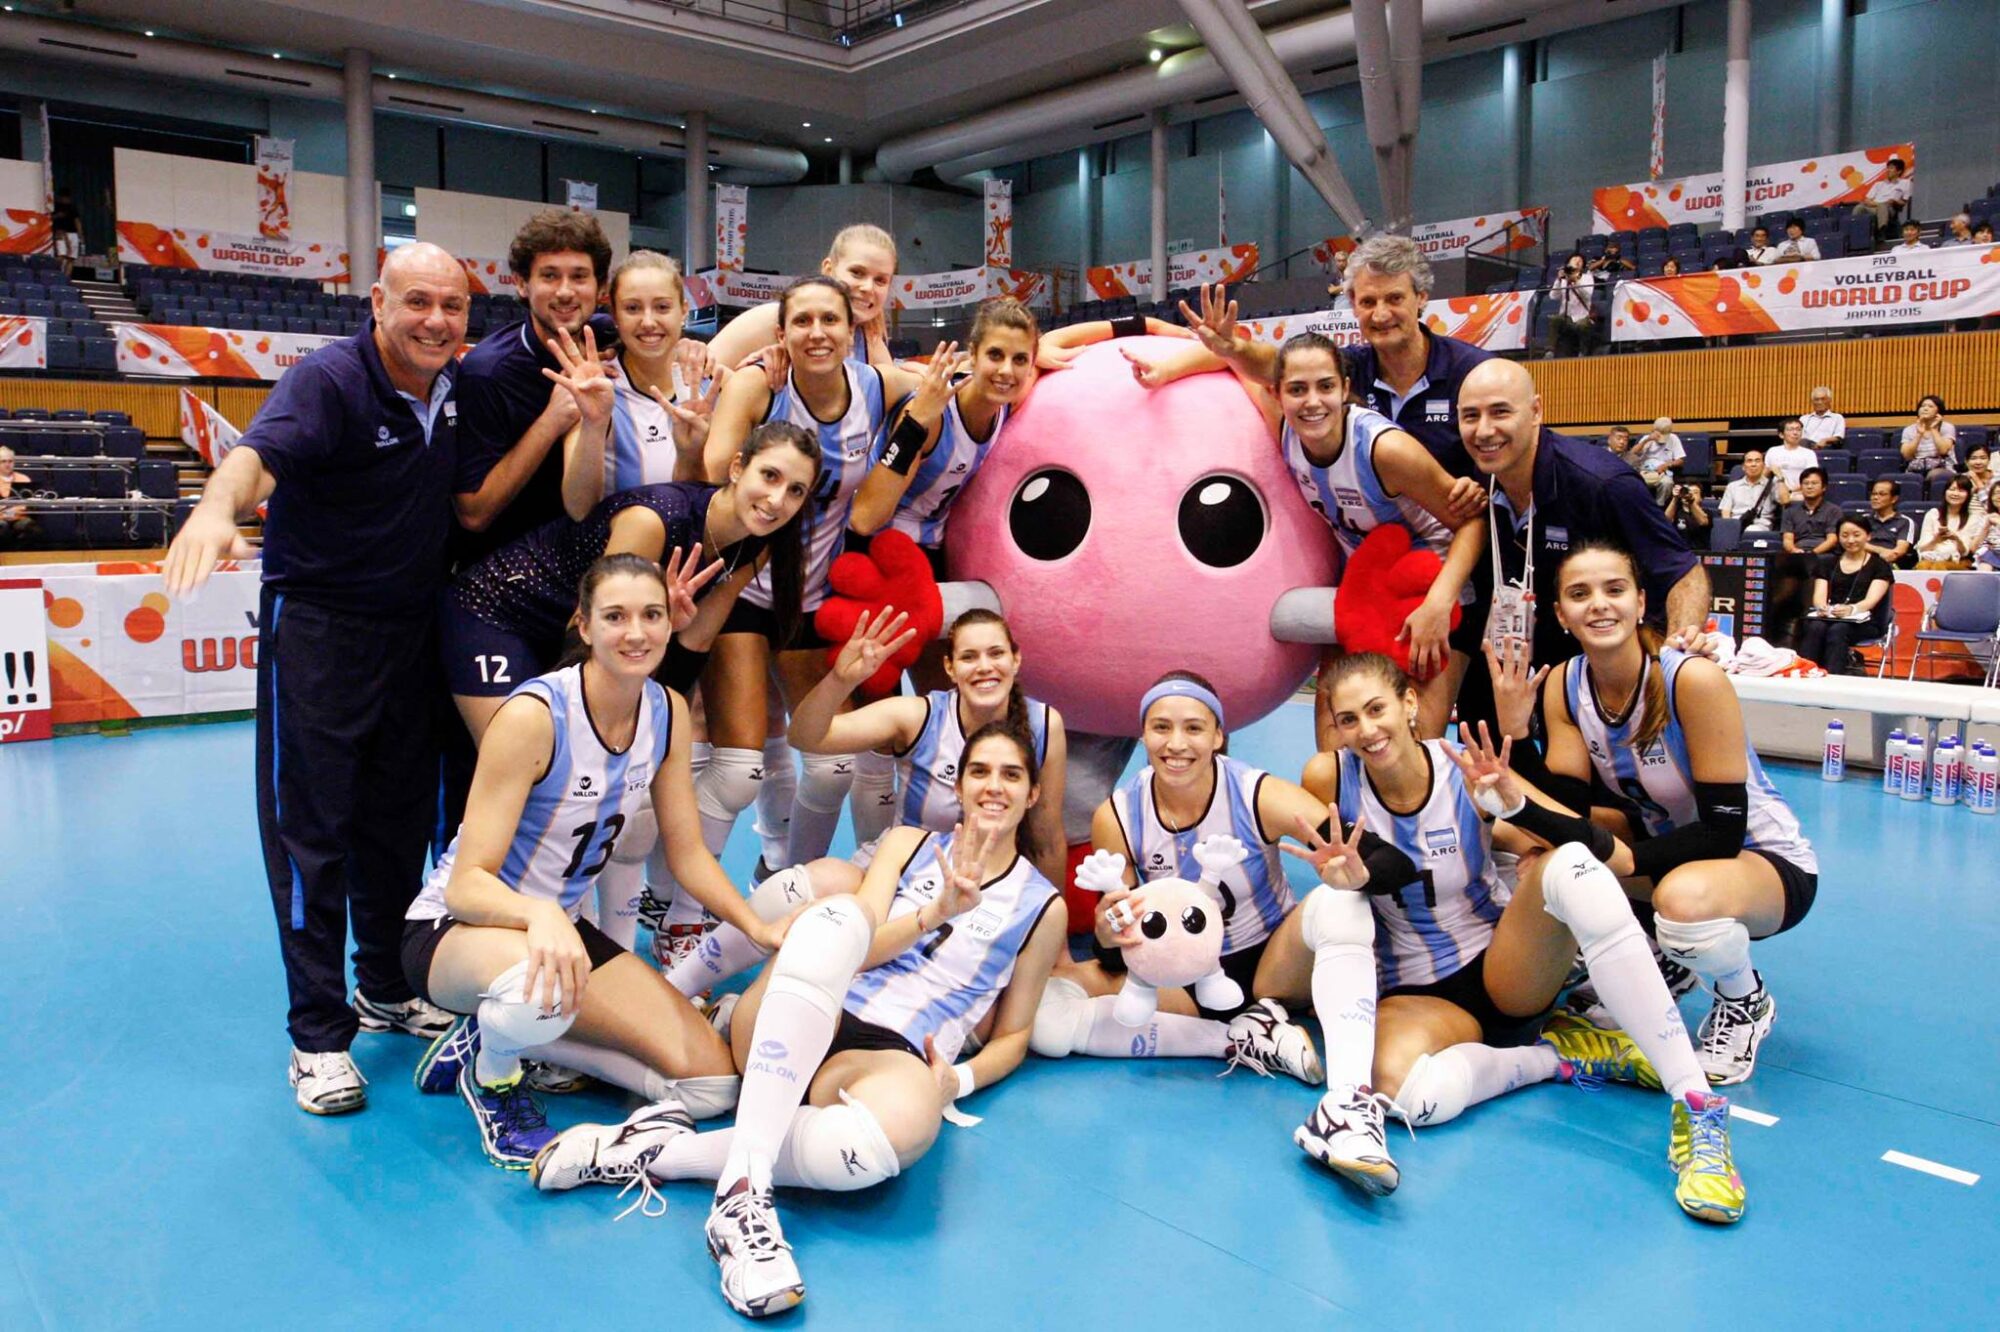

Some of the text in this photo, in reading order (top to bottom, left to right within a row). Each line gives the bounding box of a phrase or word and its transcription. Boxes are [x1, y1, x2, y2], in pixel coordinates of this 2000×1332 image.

[1755, 183, 1794, 202] CUP
[1442, 235, 1470, 250] CUP
[212, 248, 306, 266] WORLD CUP
[1834, 268, 1937, 286] VOLLEYBALL
[915, 283, 976, 300] WORLD CUP
[1802, 278, 1971, 309] WORLD CUP
[1845, 307, 1922, 320] JAPAN 2015
[1305, 321, 1360, 332] VOLLEYBAL
[1546, 541, 1569, 551] ARG
[475, 655, 511, 683] 12
[1642, 756, 1666, 767] ARG
[1830, 744, 1841, 776] VAAM
[1908, 761, 1920, 794] VAAM
[629, 781, 646, 792] ARG
[1984, 773, 1995, 808] VAAM
[562, 813, 626, 878] 13
[1431, 846, 1457, 857] ARG
[967, 922, 991, 938] ARG
